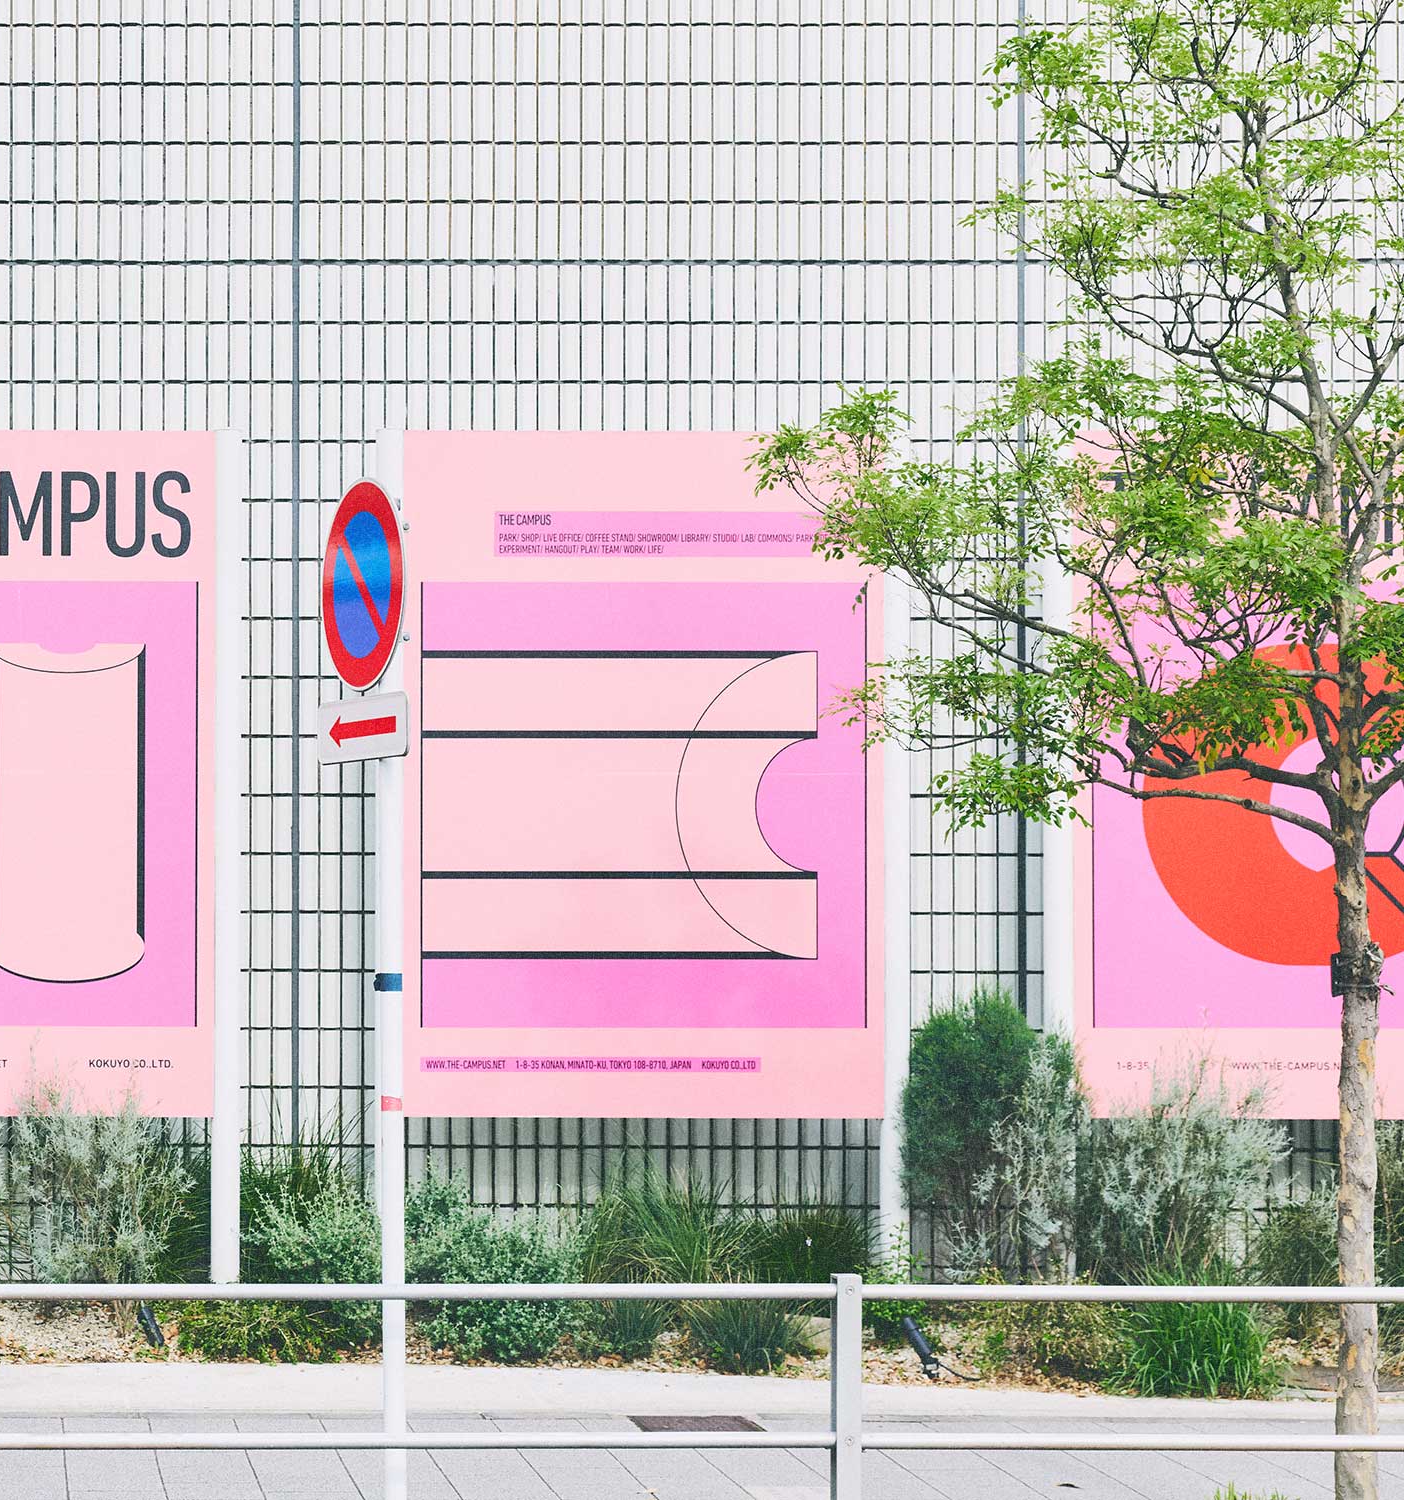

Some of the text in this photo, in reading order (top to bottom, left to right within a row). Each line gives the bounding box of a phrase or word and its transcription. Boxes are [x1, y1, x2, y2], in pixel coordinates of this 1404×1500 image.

[499, 514, 552, 526] THE CAMPUS
[499, 533, 519, 542] PARK/
[521, 533, 541, 542] SHOP/
[543, 533, 557, 542] LIVE
[559, 533, 584, 542] OFFICE/
[585, 533, 609, 542] COFFEE
[611, 533, 636, 542] STAND/
[637, 533, 679, 542] SHOWROOM/
[681, 533, 712, 542] LIBRARY/
[713, 533, 739, 542] STUDIO/
[741, 533, 756, 542] LAB/
[758, 533, 794, 542] COMMONS/
[499, 545, 664, 554] EXPERIMENT/ HANGOUT/ PLAY/ TEAM/ WORK/ LIFE/
[88, 1059, 130, 1068] KOKUYO
[426, 1060, 506, 1070] WWW.THE-CAMPUS.NET
[516, 1060, 539, 1070] 1-8-35
[541, 1060, 566, 1070] KONAN,
[567, 1060, 608, 1070] MINATO-KU,
[609, 1060, 632, 1070] TOKYO
[633, 1060, 668, 1070] 108-8710,
[669, 1060, 692, 1070] JAPAN
[702, 1060, 729, 1070] KOKUYO
